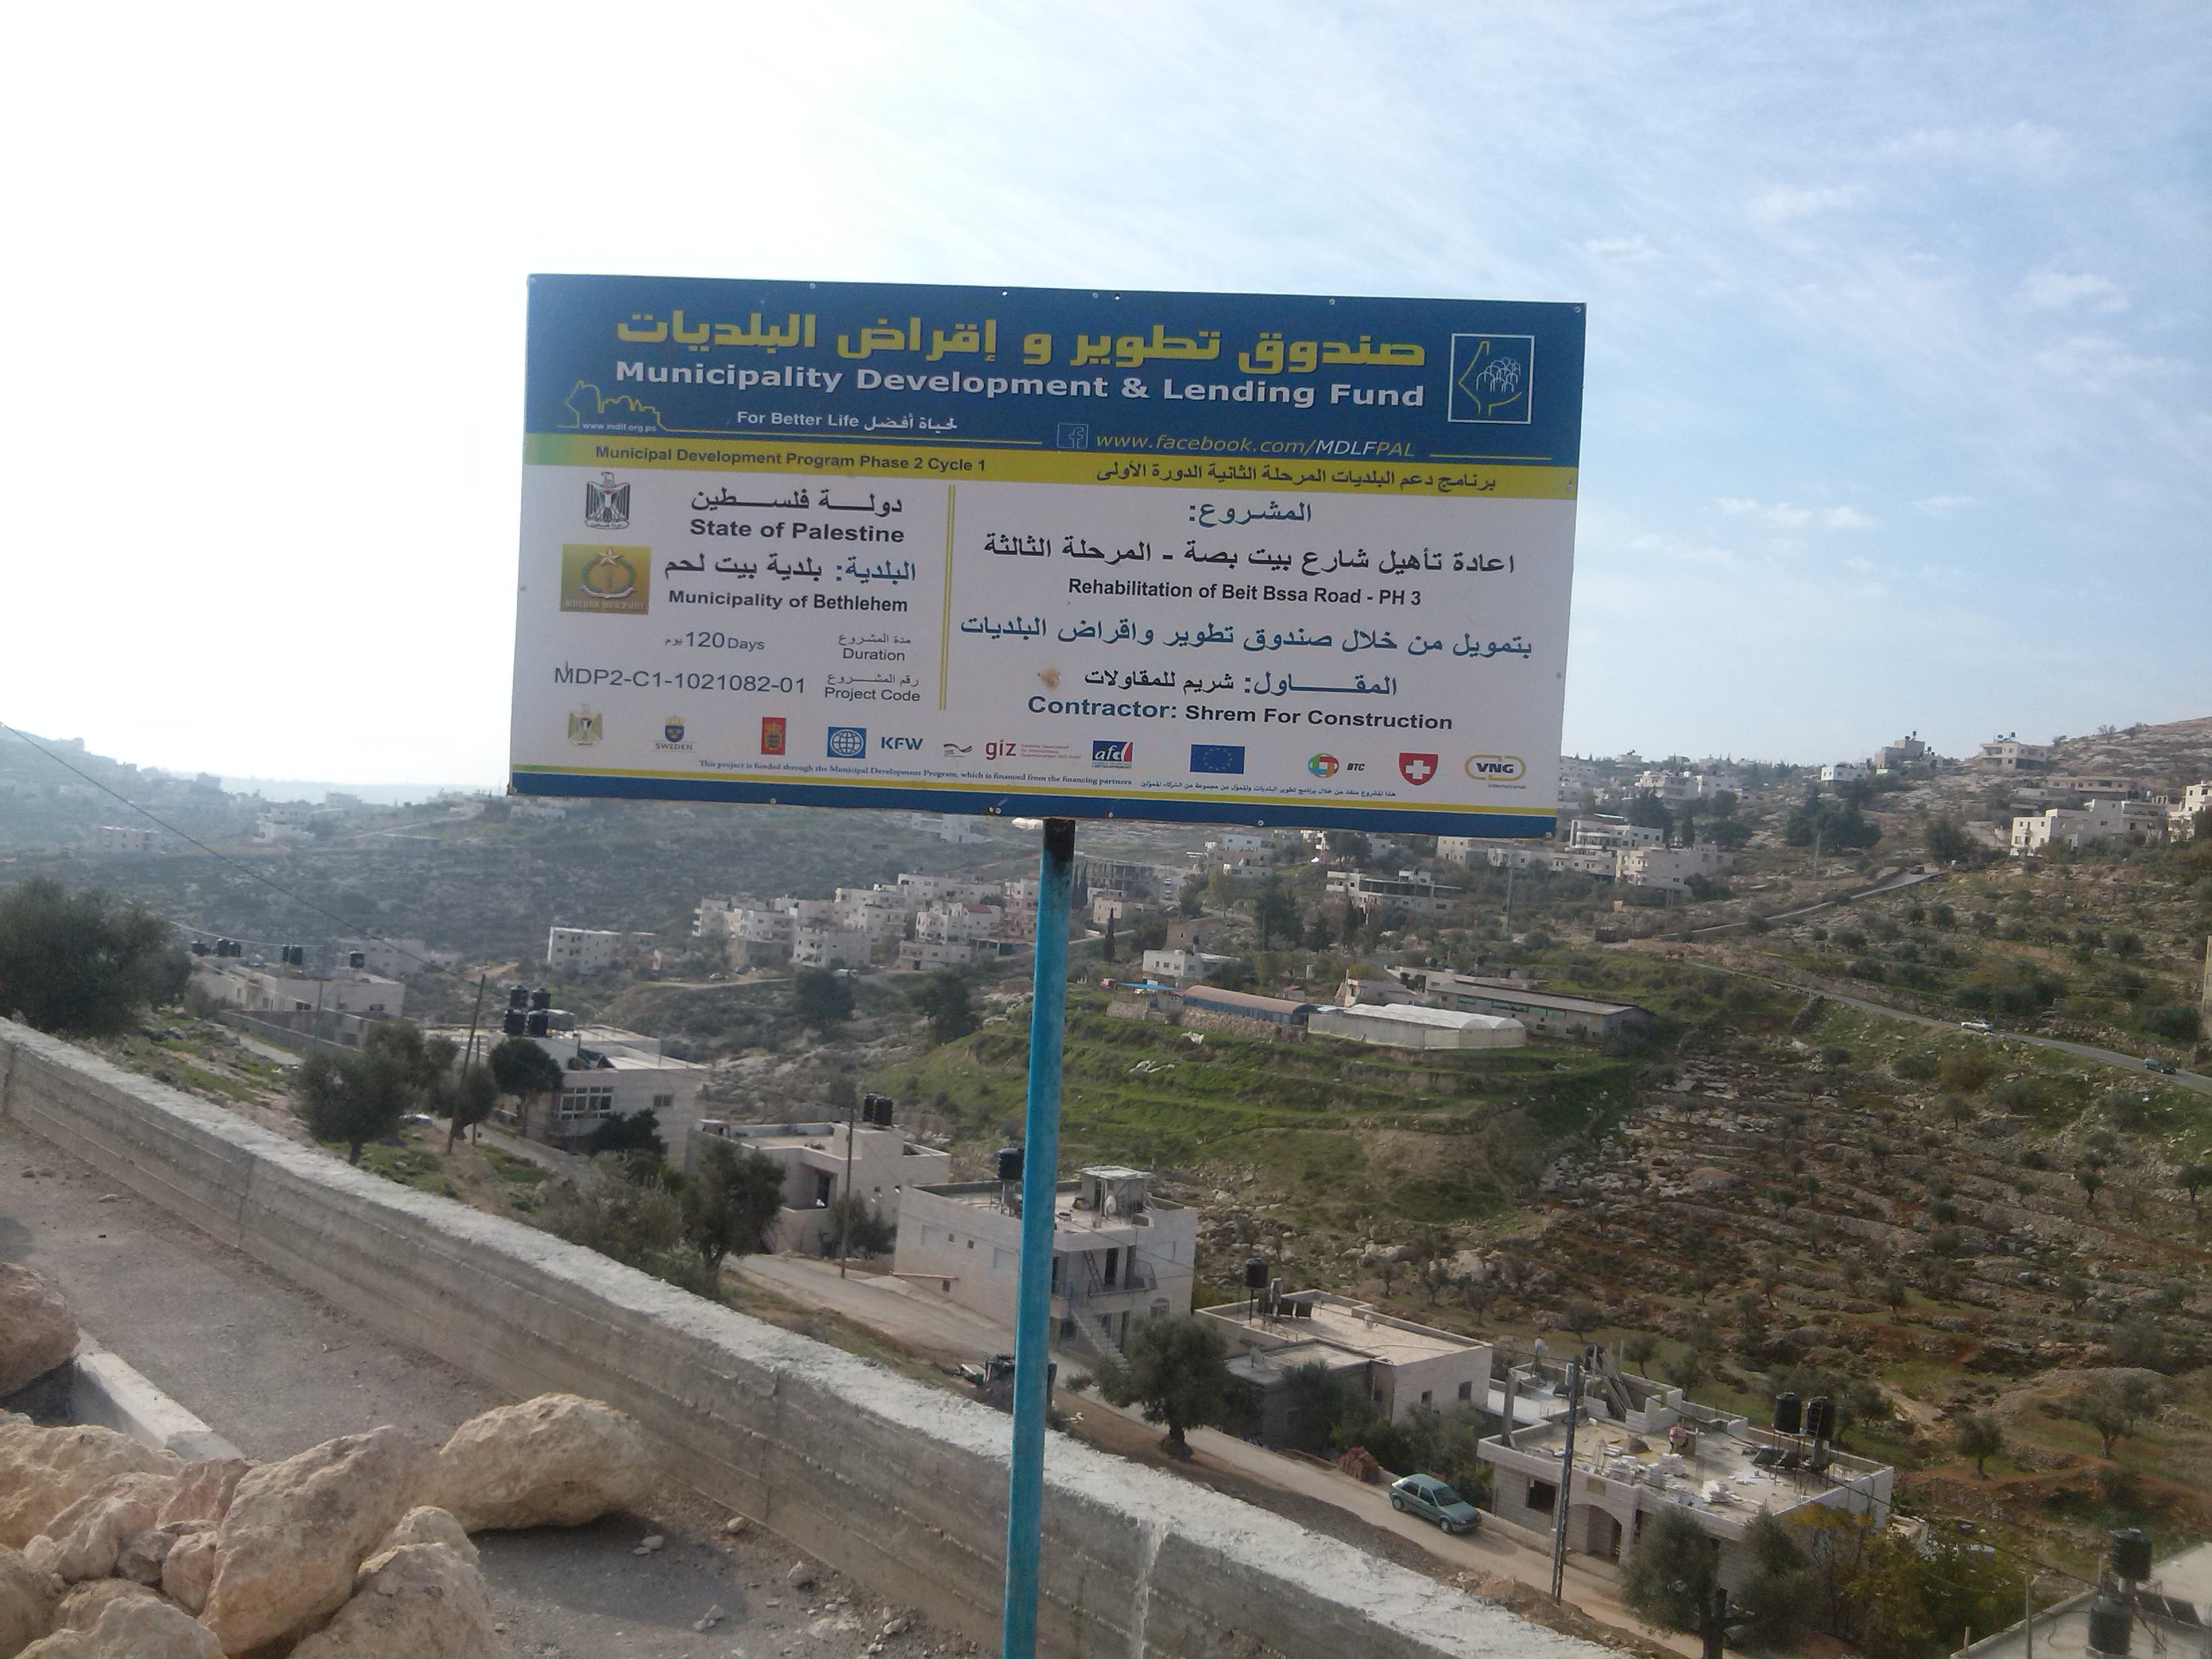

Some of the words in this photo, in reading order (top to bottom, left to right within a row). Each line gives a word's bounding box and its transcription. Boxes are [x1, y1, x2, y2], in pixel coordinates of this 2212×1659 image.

[617, 310, 816, 354] البلديات
[836, 317, 997, 363] إقراض
[1023, 332, 1052, 366] و
[1070, 324, 1221, 368] تطوير
[1238, 332, 1426, 375] صندوق
[616, 361, 842, 392] Municipality
[857, 369, 1109, 398] Development
[1121, 378, 1150, 399] &
[1164, 378, 1315, 409] Lending
[1330, 384, 1424, 407] Fund
[737, 411, 765, 426] For
[771, 412, 821, 427] Better
[827, 413, 859, 428] Life
[865, 413, 914, 431] أفضل
[1096, 433, 1415, 457] www.facebook.com/MDLFPAL
[596, 445, 672, 462] Municipal
[677, 449, 781, 467] Development
[786, 453, 854, 470] Program
[859, 456, 909, 470] Phase
[914, 457, 923, 470] 2
[928, 457, 972, 473] Cycle
[979, 459, 985, 471] 1
[1097, 461, 1146, 481] الأولى
[1152, 465, 1202, 481] الدورة
[1208, 466, 1256, 483] الثانية
[1261, 468, 1326, 487] المرحلة
[1332, 470, 1394, 488] البلديات
[1399, 475, 1433, 490] دعم
[1438, 476, 1496, 491] برنامج
[691, 487, 809, 512] فلسطين
[818, 489, 903, 516] دولة
[1190, 501, 1312, 526] المشروع:
[691, 518, 752, 537] State
[760, 522, 784, 539] of
[792, 523, 905, 543] Palestine
[984, 533, 1051, 557] الثالثة
[1061, 536, 1152, 565] المرحلة
[1184, 541, 1239, 569] بصة
[664, 552, 705, 579] لحم
[714, 555, 758, 579] بيت
[766, 553, 822, 581] بلدية
[1248, 545, 1293, 570] بيت
[1301, 549, 1370, 575] شارع
[1378, 548, 1442, 575] تأهيل
[1453, 552, 1515, 573] اعادة
[836, 556, 915, 584] البلدية:
[669, 590, 782, 609] Municipality
[789, 594, 808, 609] of
[813, 595, 908, 612] Bethlehem
[1068, 578, 1193, 599] Rehabilitation
[1199, 581, 1217, 599] of
[1222, 583, 1257, 601] Beit
[1263, 584, 1308, 602] Bssa
[1315, 586, 1362, 605] Road
[1379, 588, 1406, 606] PH
[1412, 590, 1422, 606] 3
[838, 634, 889, 645] المشروع
[893, 634, 911, 644] مدة
[960, 616, 1047, 639] البلديات
[1057, 618, 1153, 647] واقراض
[1164, 624, 1235, 649] تطوير
[665, 637, 682, 647] يوم
[686, 632, 725, 649] 120
[728, 637, 765, 652] Days
[1243, 629, 1333, 654] صندوق
[1343, 629, 1397, 654] خلال
[1409, 635, 1443, 655] من
[1452, 633, 1532, 657] بتمويل
[843, 648, 905, 661] Duration
[554, 666, 805, 694] MDP2-C1-1021082-01
[827, 673, 895, 684] المشروع
[900, 676, 920, 687] رقم
[1085, 668, 1176, 692] للمقاولات
[1183, 672, 1235, 695] شريم
[1244, 673, 1397, 698] المقاول:
[825, 687, 876, 701] Project
[881, 689, 920, 701] Code
[1028, 695, 1178, 720] Contractor:
[1185, 705, 1256, 724] Shrem
[1264, 709, 1302, 726] For
[1307, 710, 1452, 732] Construction
[655, 742, 693, 751] SWEDEN
[985, 739, 1017, 760] giz
[783, 764, 813, 772] through
[830, 766, 868, 774] Municipal
[871, 767, 921, 776] Development
[924, 770, 958, 778] Program,
[1062, 776, 1097, 784] financing
[1347, 762, 1365, 771] BTC
[1476, 762, 1514, 774] VNG
[1279, 787, 1296, 795] تطوير
[1298, 787, 1316, 795] برنامج
[1361, 790, 1383, 798] المشروع
